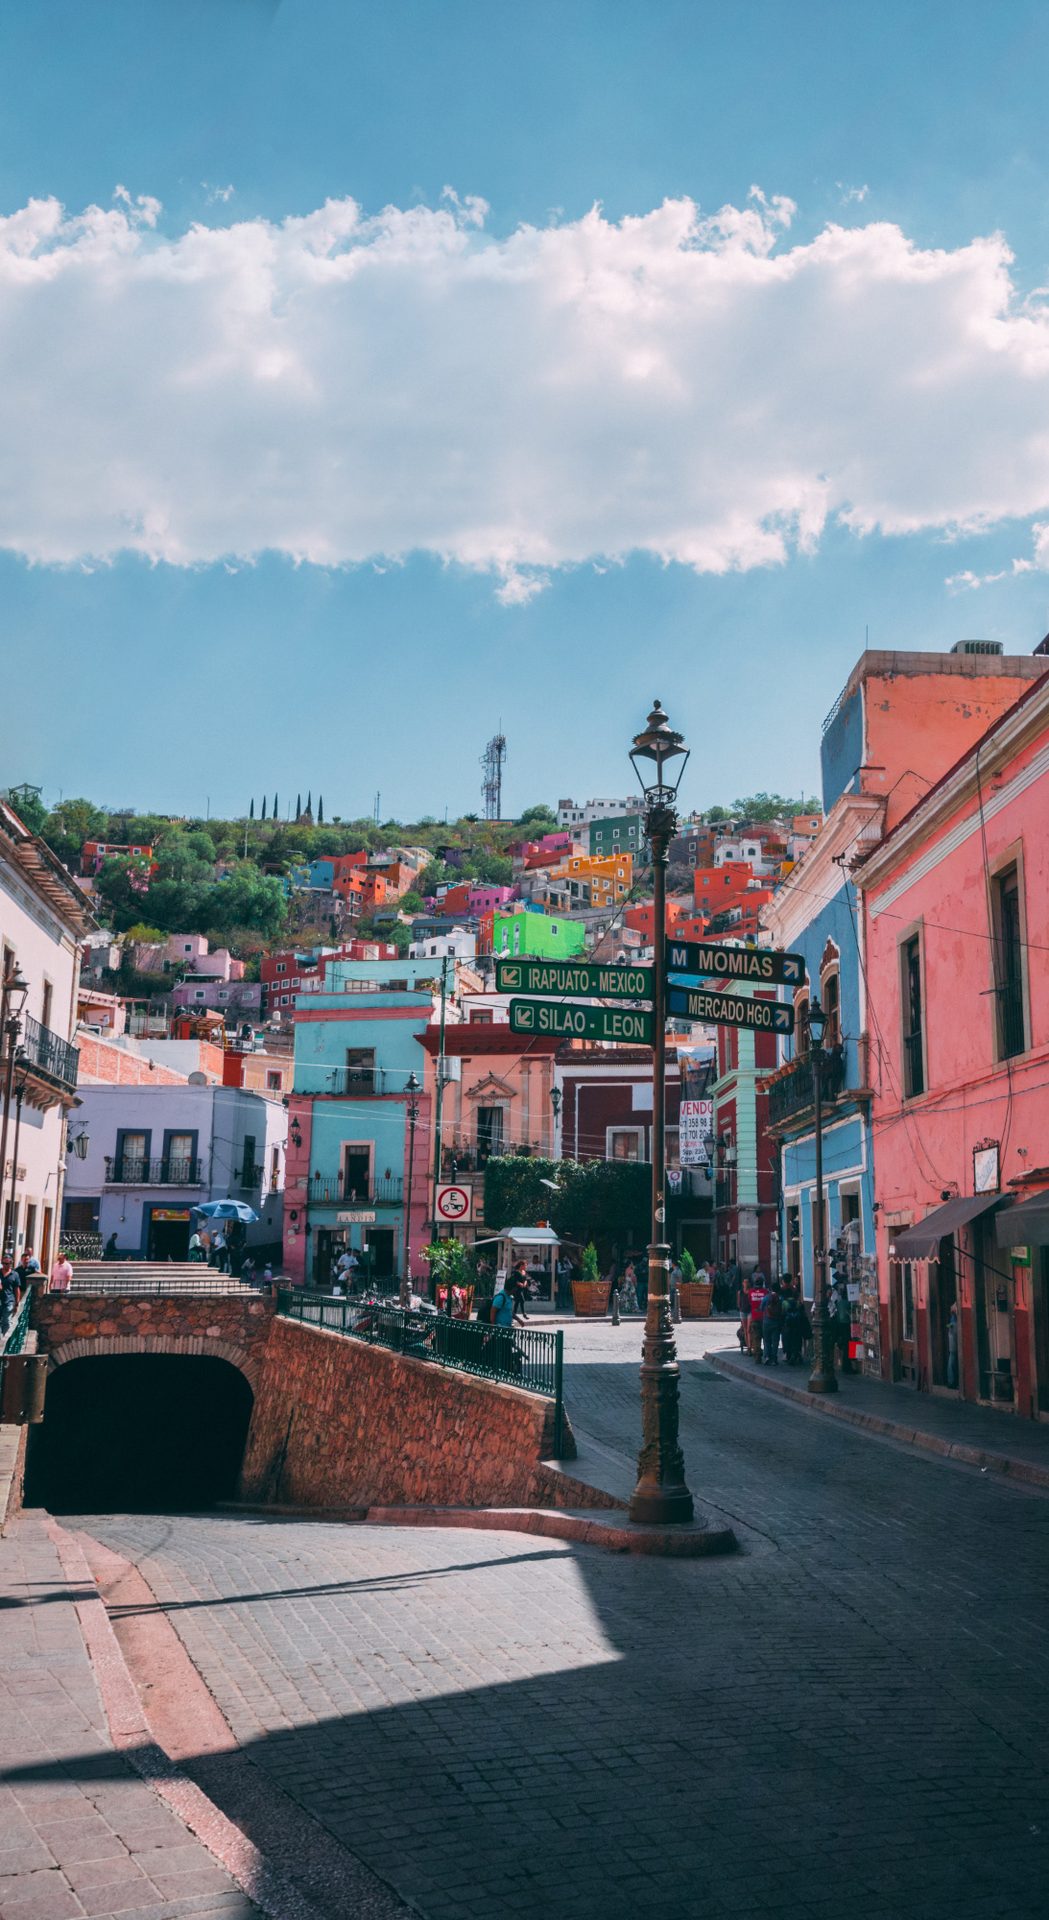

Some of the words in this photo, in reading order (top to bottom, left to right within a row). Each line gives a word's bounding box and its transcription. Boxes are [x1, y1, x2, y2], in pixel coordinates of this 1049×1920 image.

[672, 948, 687, 967] M
[699, 949, 774, 977] MOMIAS
[528, 968, 589, 992] IRAPUATO
[599, 971, 645, 993] MEXICO
[539, 1008, 586, 1033] SILAO
[603, 1014, 645, 1038] LEON
[688, 994, 745, 1022] MERCADO
[747, 1003, 773, 1027] HGO.
[450, 1192, 457, 1201] E
